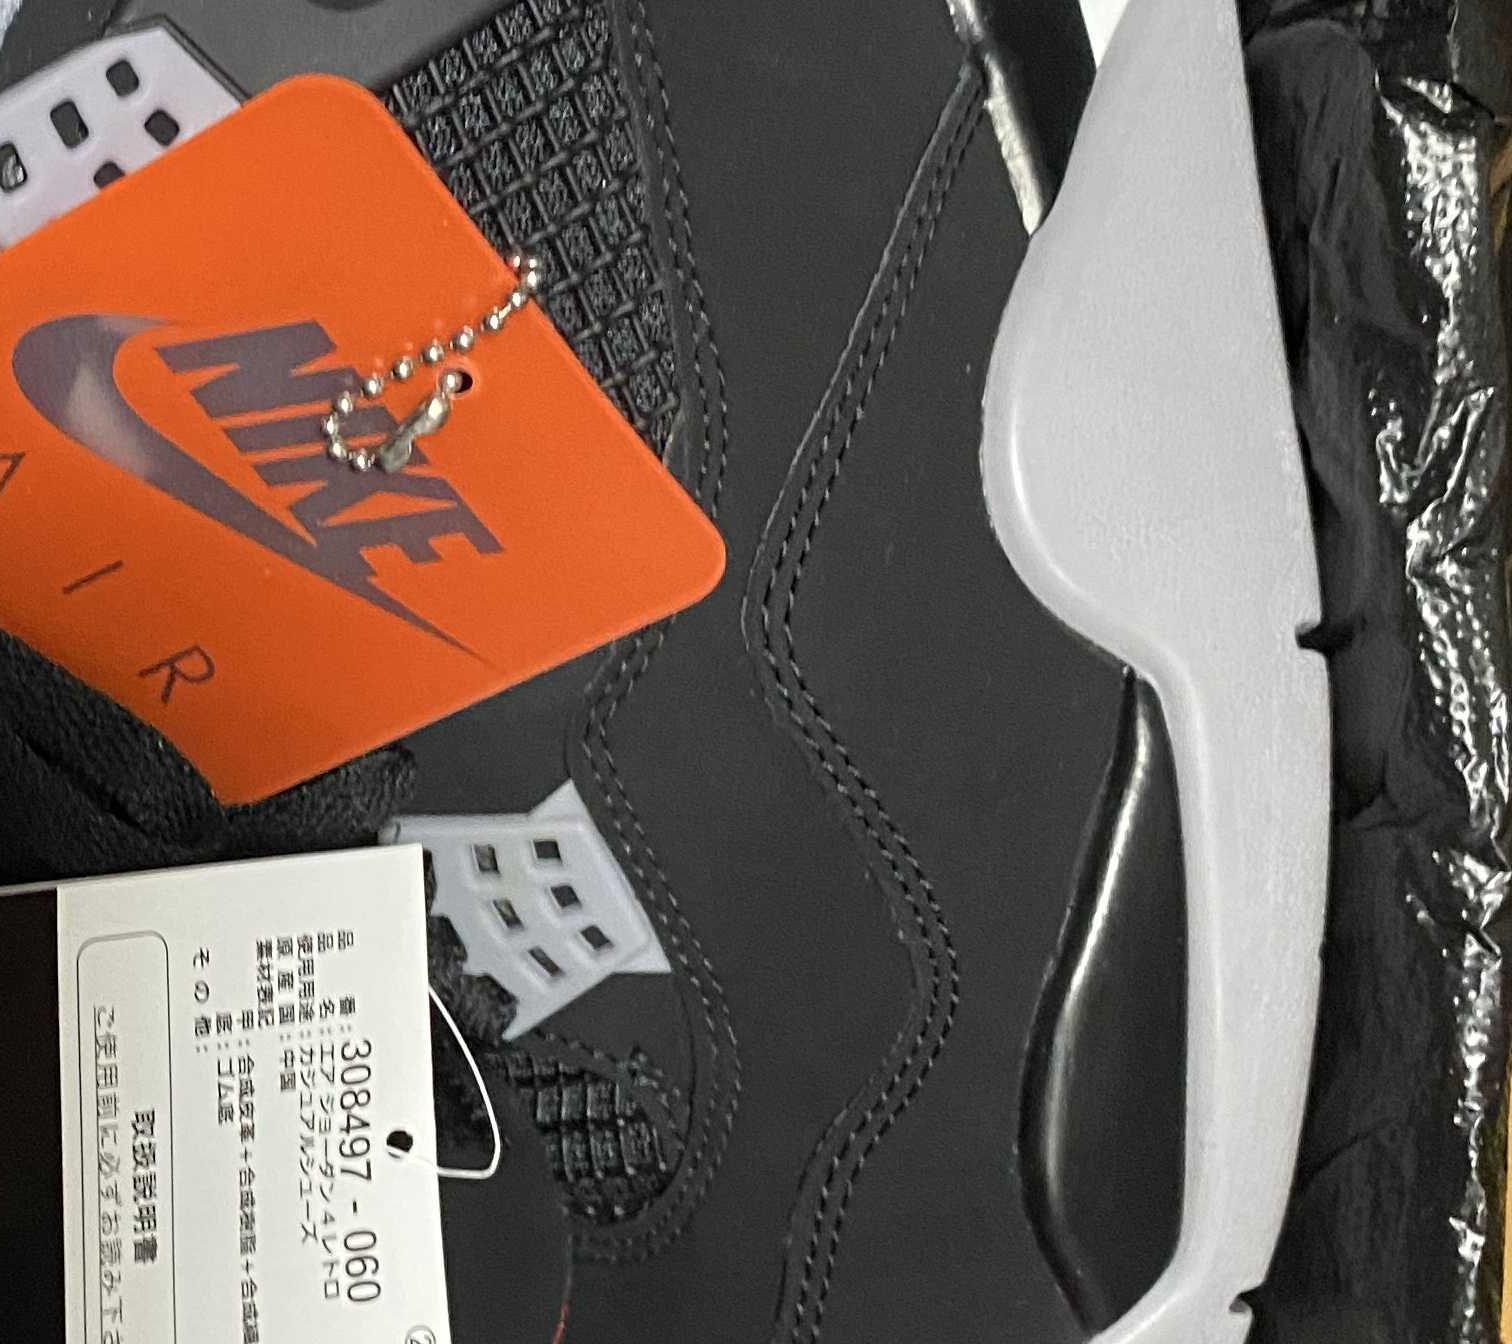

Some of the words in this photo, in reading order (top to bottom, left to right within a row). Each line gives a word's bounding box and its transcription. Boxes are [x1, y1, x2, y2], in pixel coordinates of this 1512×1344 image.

[154, 320, 505, 575] NIKE
[338, 1039, 373, 1183] 308497
[130, 1108, 158, 1266] 取扱説明書
[343, 1230, 382, 1304] 060
